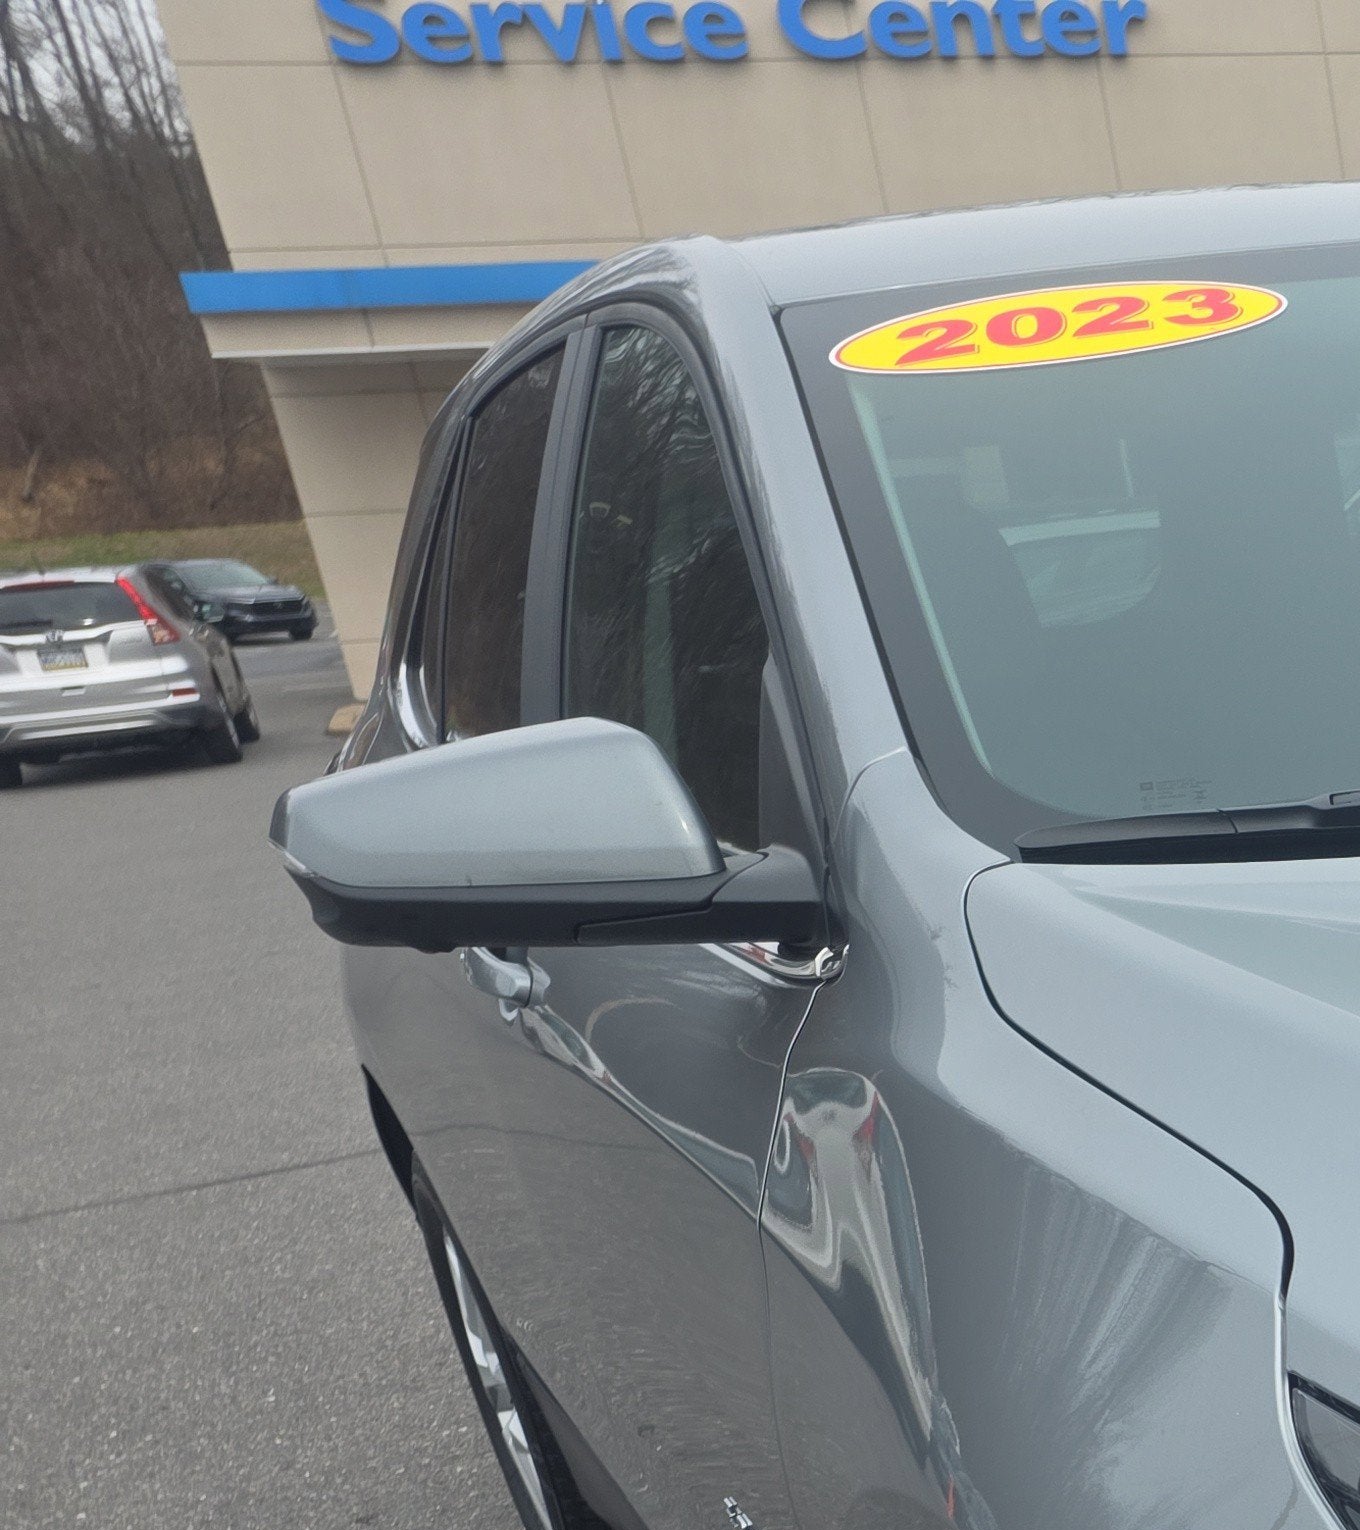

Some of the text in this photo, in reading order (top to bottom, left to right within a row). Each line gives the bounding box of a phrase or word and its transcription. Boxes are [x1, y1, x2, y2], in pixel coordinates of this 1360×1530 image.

[315, 0, 1148, 64] Service Center
[894, 287, 1244, 367] 2023
